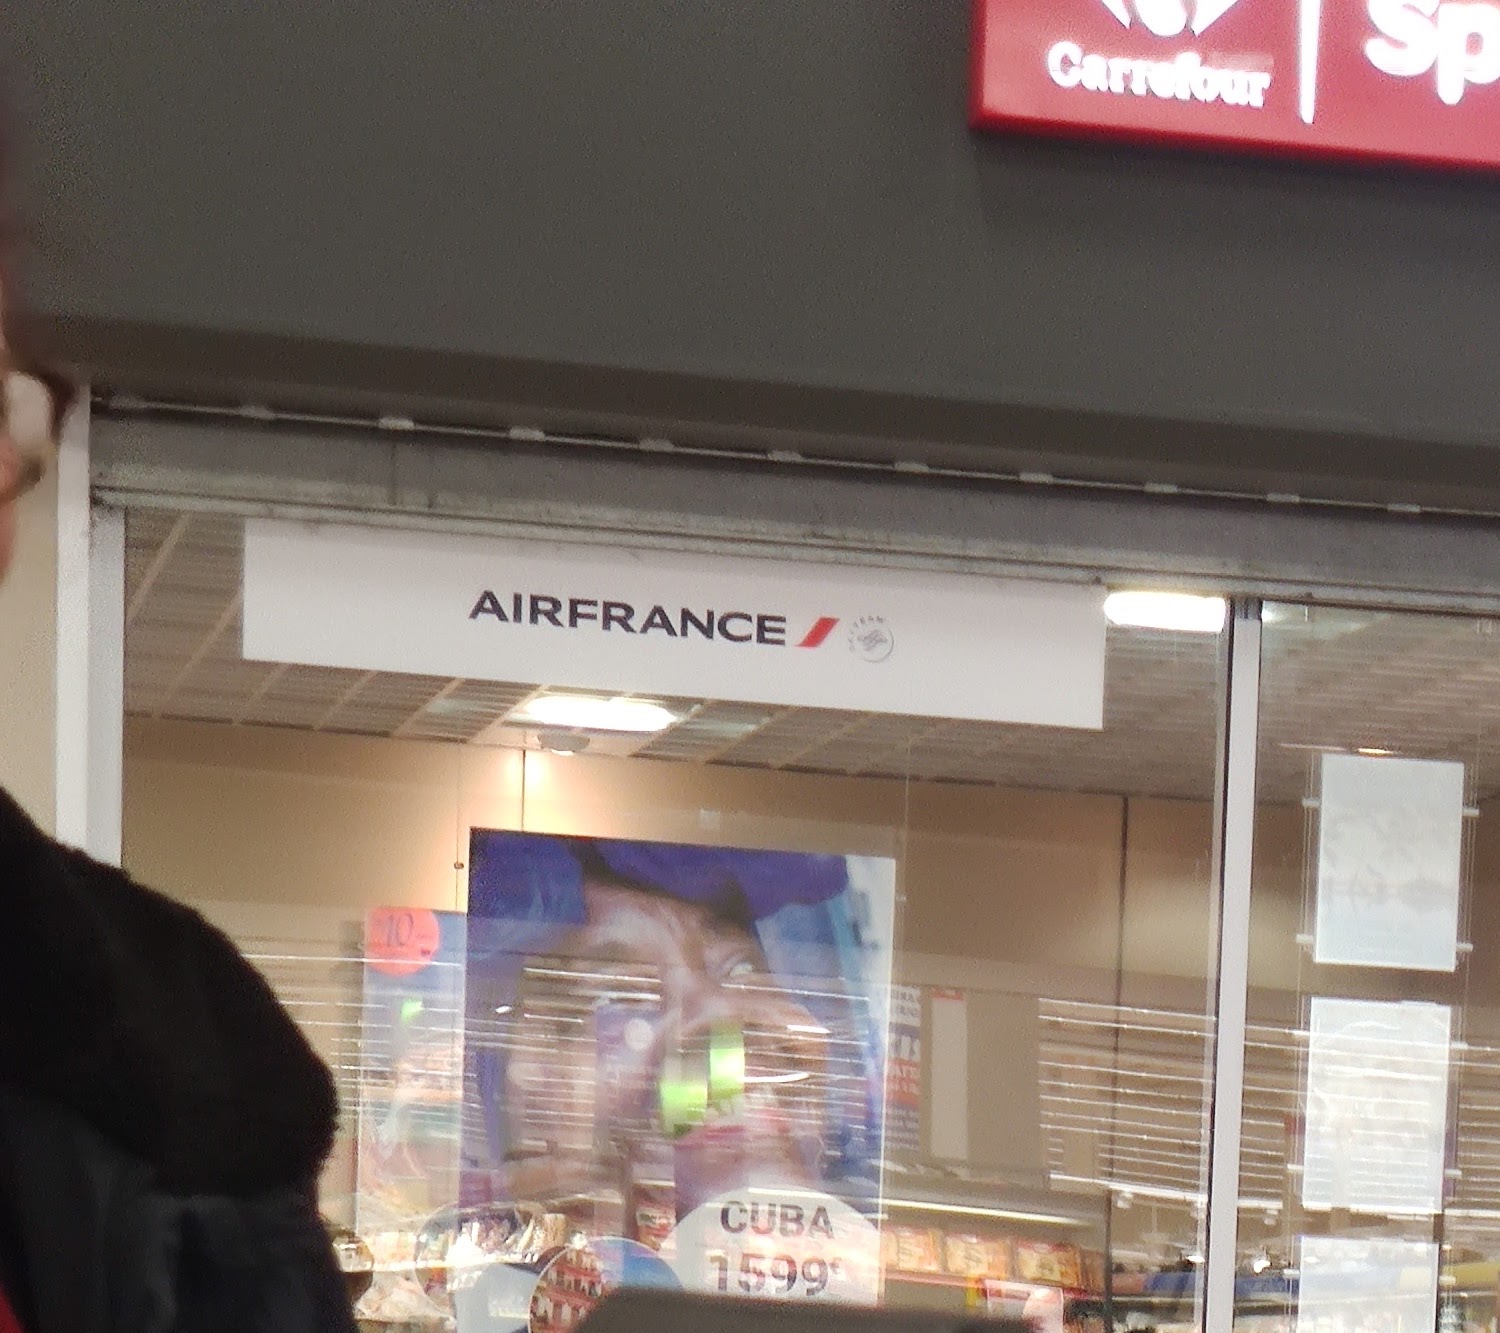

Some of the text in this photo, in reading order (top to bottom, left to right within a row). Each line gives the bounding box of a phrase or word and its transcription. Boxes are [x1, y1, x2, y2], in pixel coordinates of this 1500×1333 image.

[1047, 40, 1272, 108] Carrefour
[468, 589, 788, 647] AIRFRANCE
[719, 1199, 836, 1239] CUBA
